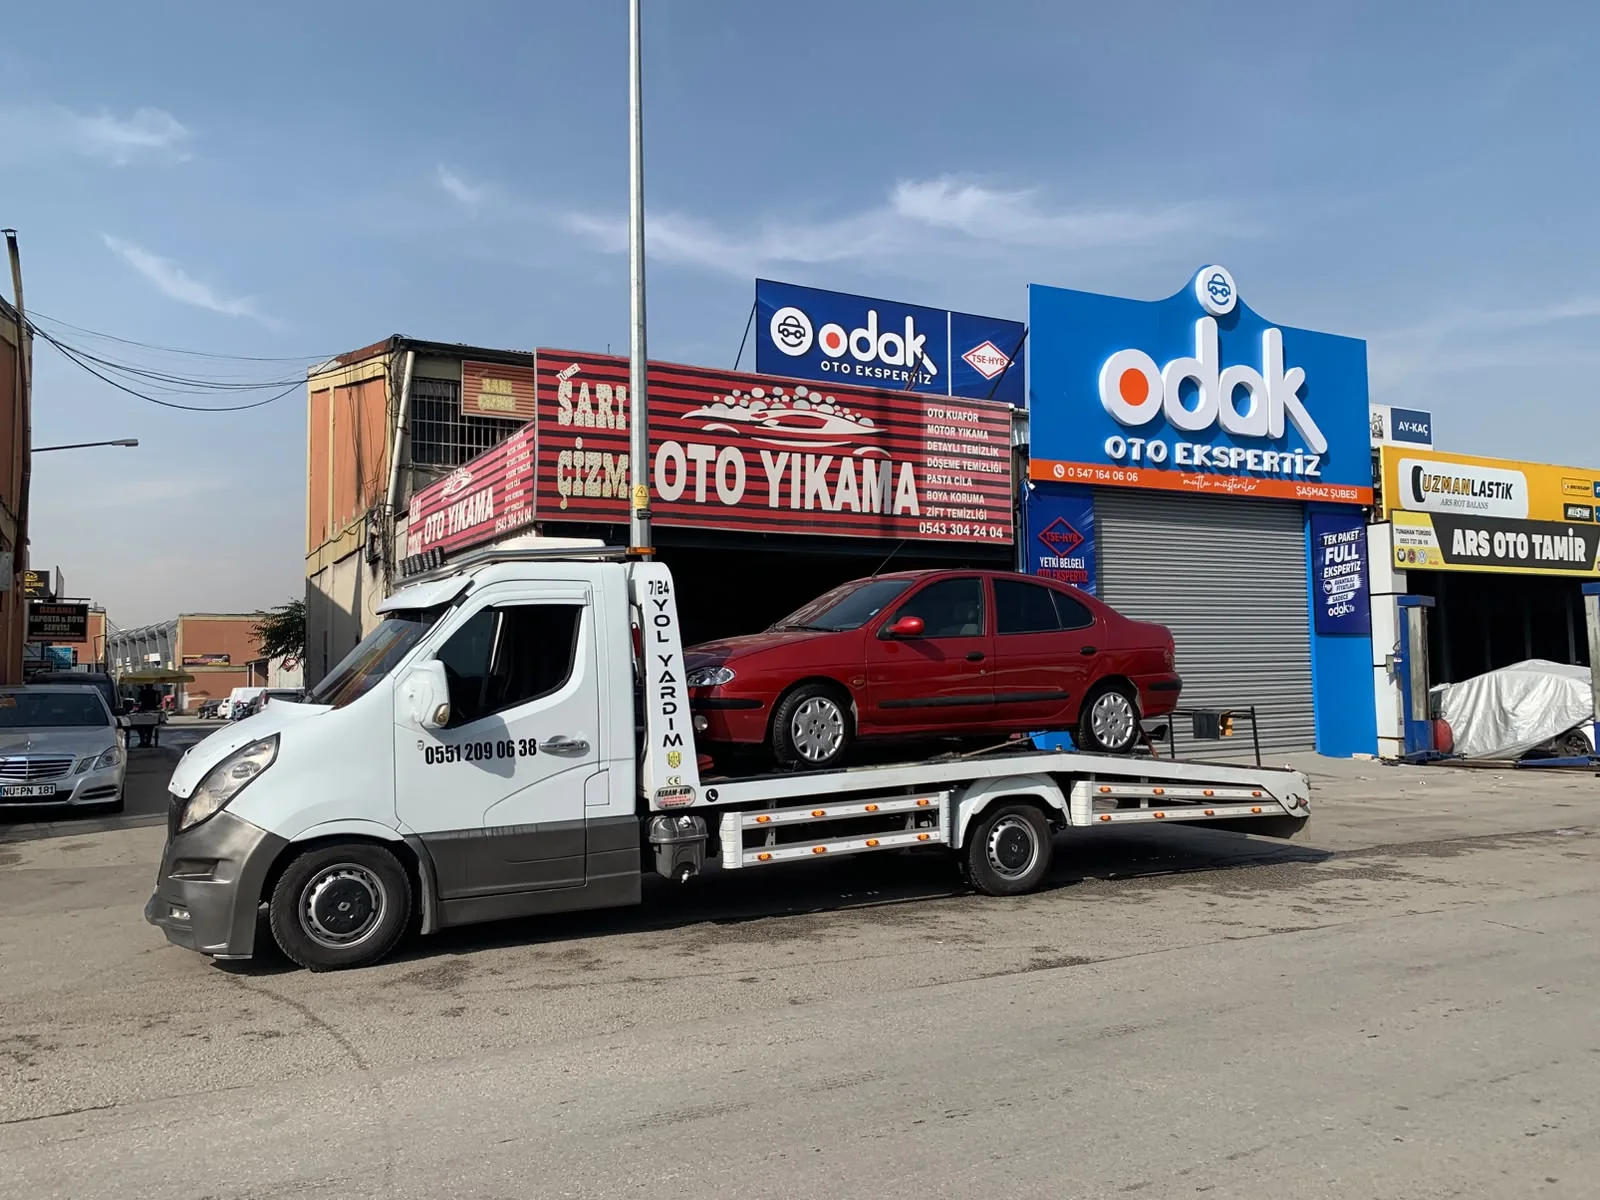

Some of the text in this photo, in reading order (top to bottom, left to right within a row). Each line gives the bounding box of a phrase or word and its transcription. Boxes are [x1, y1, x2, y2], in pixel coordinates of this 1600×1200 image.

[818, 309, 937, 376] odak
[972, 354, 1005, 366] TSE-HYB
[821, 361, 932, 384] OTO EKSPERTİZ
[1099, 316, 1327, 454] odak
[558, 381, 626, 430] SARI
[927, 408, 944, 418] OTO
[927, 424, 989, 440] MOTOR YIKAMA
[1398, 421, 1428, 436] AY-KAÇ
[927, 441, 999, 457] DETAYLI TEMİZLİK
[1105, 436, 1321, 476] OTO EKSPERTİZ
[557, 436, 633, 510] ÇİZM
[927, 457, 1002, 473] DÖŞEME TEMİZLİĞİ
[654, 440, 920, 516] OTO YIKAMA
[926, 474, 973, 487] PASTA CİLA
[1068, 467, 1138, 481] 0 547 164 06 06
[926, 491, 985, 504] BOYA KORUMA
[1296, 485, 1358, 499] ŞAŞMAZ ŞUBESİ
[425, 511, 445, 544] OTO
[448, 486, 494, 535] YIKAMA
[926, 505, 987, 520] ZİFT TEMİZLİĞİ
[919, 522, 1004, 538] 0543 304 24 04
[1046, 532, 1078, 543] TSE-HYB
[1324, 530, 1359, 546] TEK PAKET
[1452, 527, 1586, 562] ARS OTO TAMİR
[1040, 556, 1085, 569] YETKİ BELGELİ
[1325, 544, 1359, 565] FULL
[1324, 561, 1361, 578] EKSPERTİZ
[648, 580, 670, 596] 7/24
[652, 599, 671, 643] YOL
[657, 654, 684, 747] YARDIM
[425, 738, 537, 764] 0551 209 06 38
[3, 786, 54, 796] NU PN 181
